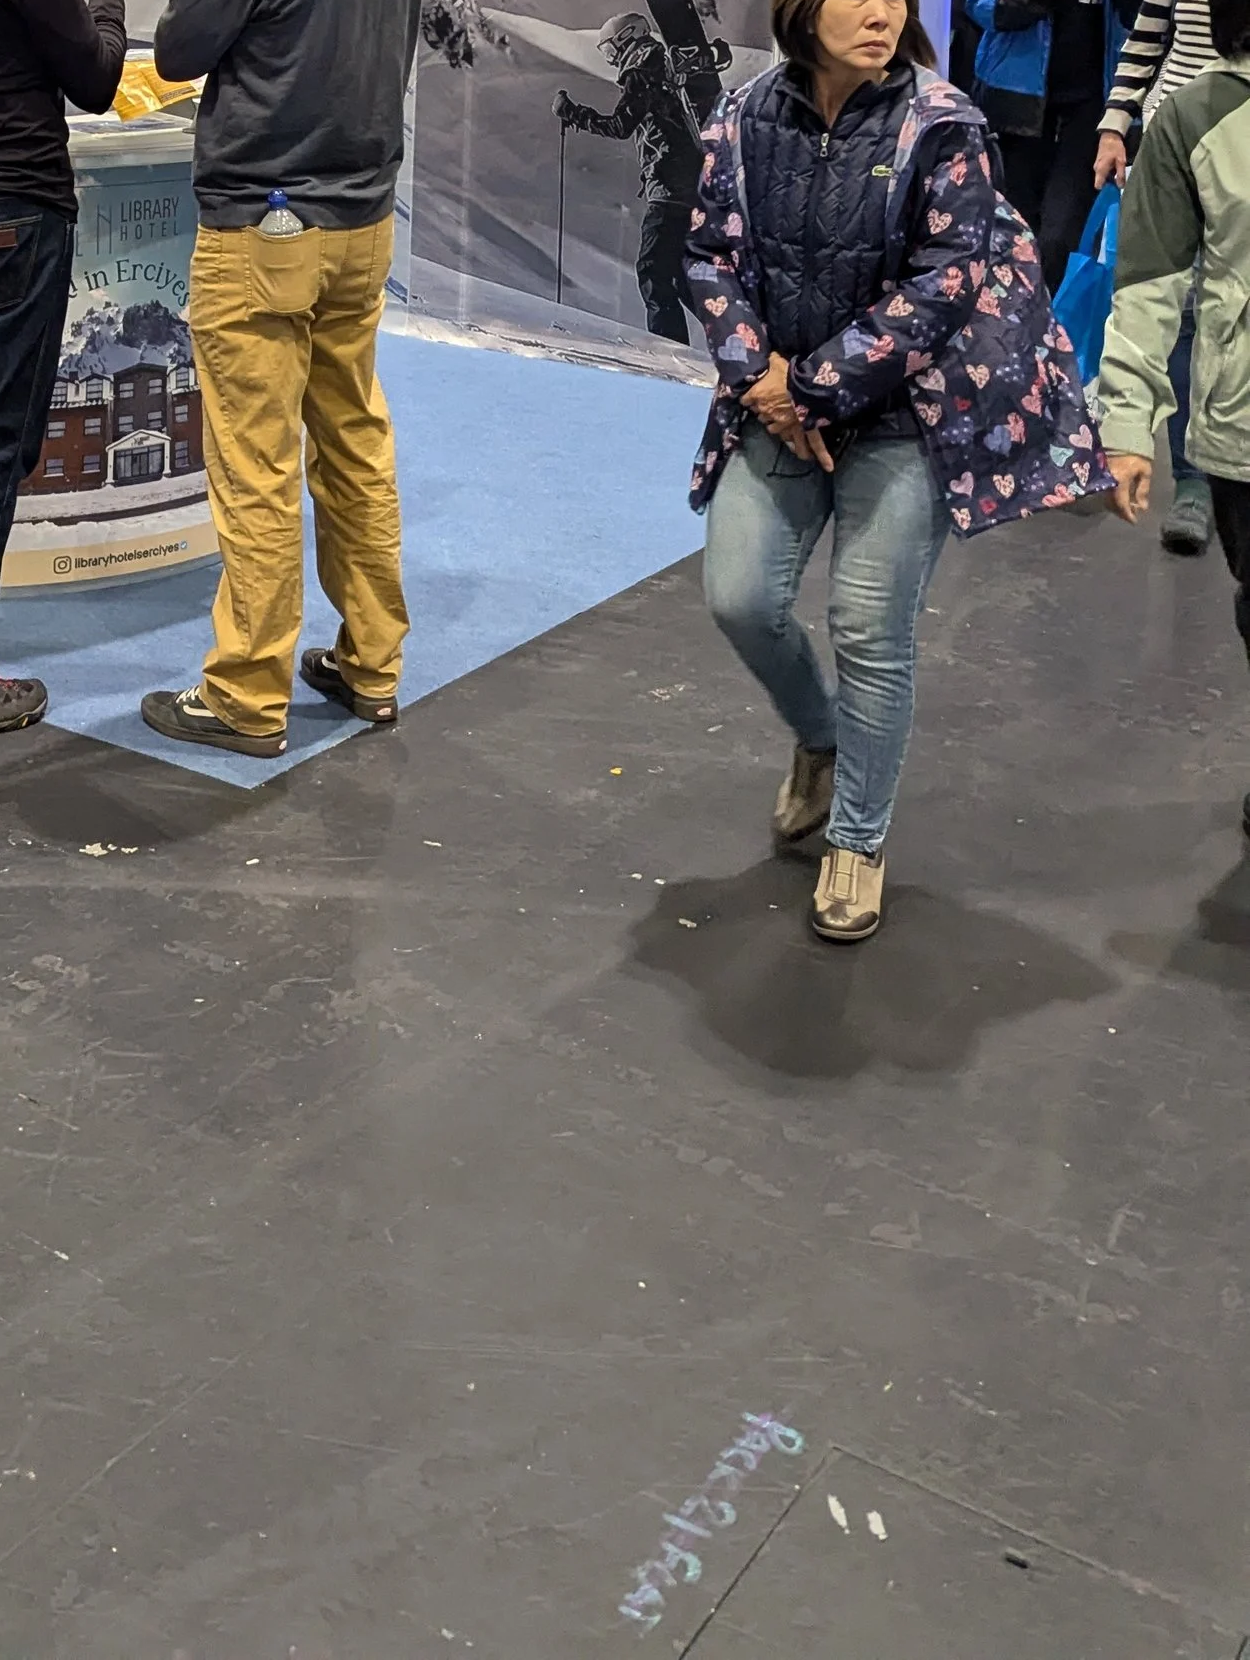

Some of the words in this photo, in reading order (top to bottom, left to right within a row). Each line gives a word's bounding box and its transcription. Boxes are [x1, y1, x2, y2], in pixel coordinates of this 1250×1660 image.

[120, 197, 180, 223] LIBRARY
[120, 221, 179, 241] HOTEL
[84, 268, 110, 292] in
[115, 258, 190, 308] Erciyes
